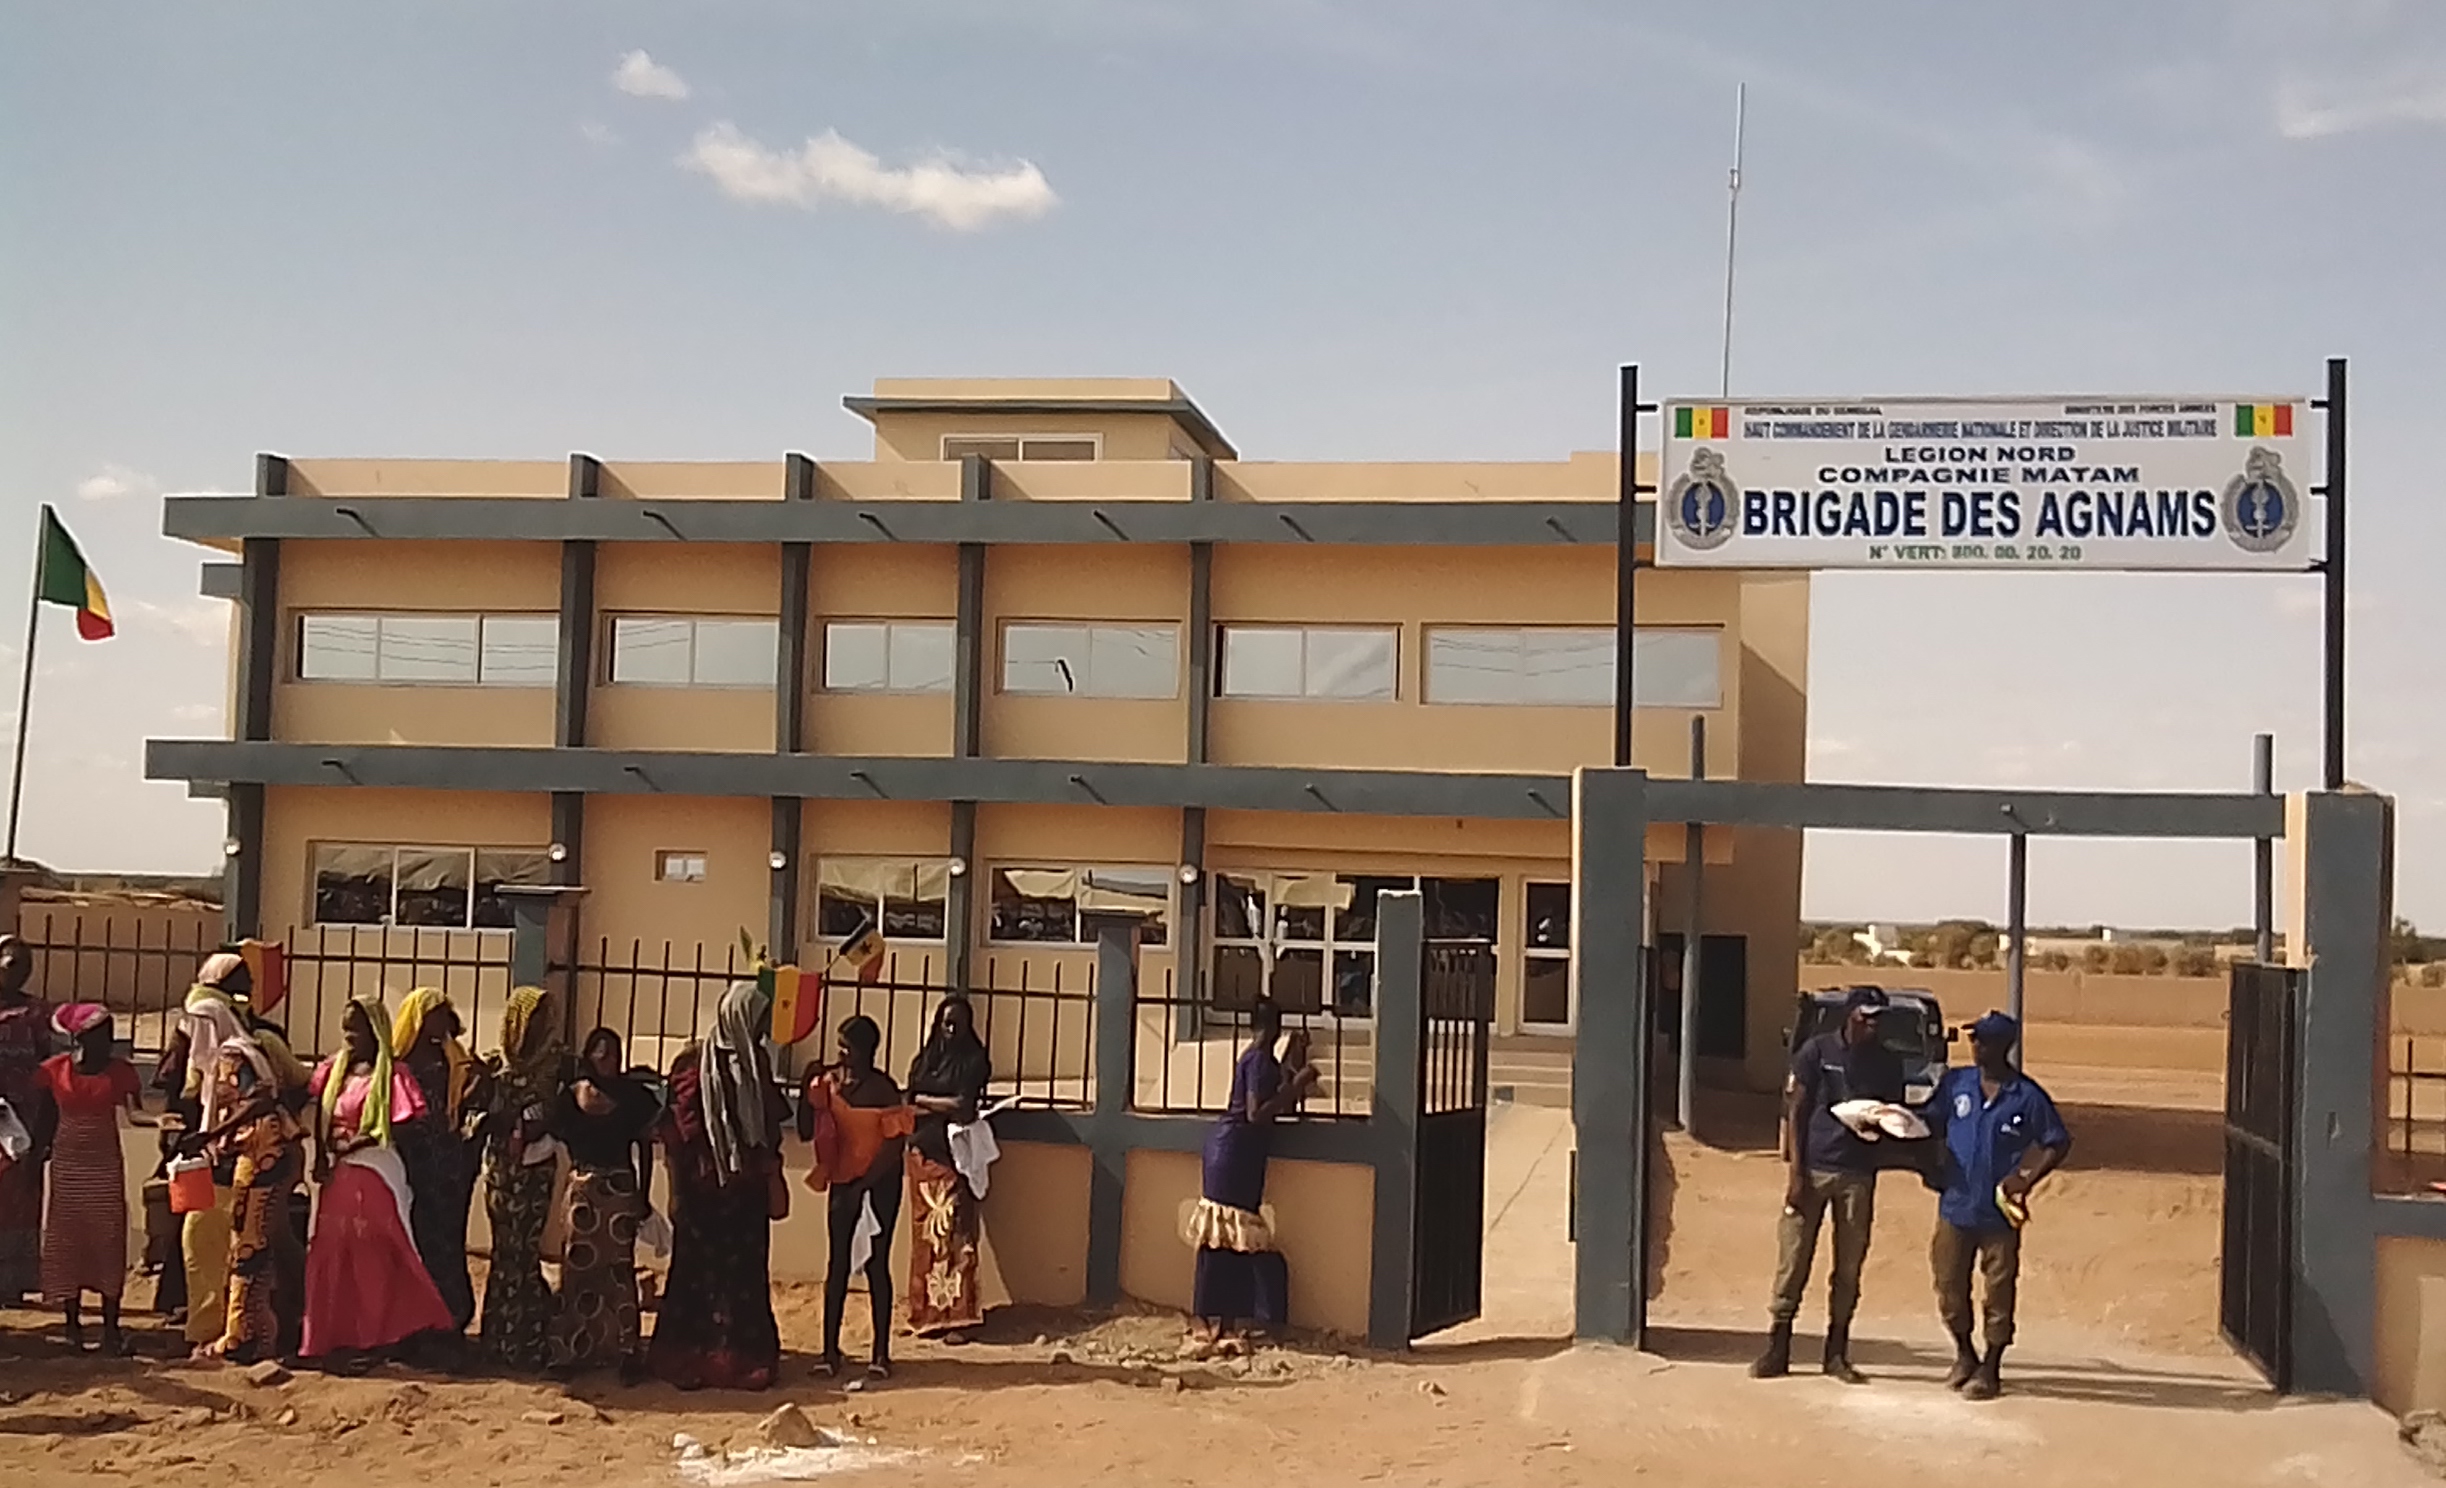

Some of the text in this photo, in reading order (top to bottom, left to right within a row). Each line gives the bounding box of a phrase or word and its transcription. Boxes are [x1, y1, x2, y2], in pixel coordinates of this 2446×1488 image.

[1858, 422, 1872, 438] DE
[1873, 422, 1886, 438] LA
[2019, 421, 2032, 438] ET
[2090, 421, 2104, 438] DE
[2106, 421, 2120, 438] LA
[2122, 420, 2164, 437] JUSTICE
[1885, 446, 2076, 463] LEGION NORD
[1818, 467, 2139, 483] COMPAGNIE MATAM
[1743, 490, 2216, 538] BRIGADE DES AGNAMS
[2058, 545, 2082, 560] 20
